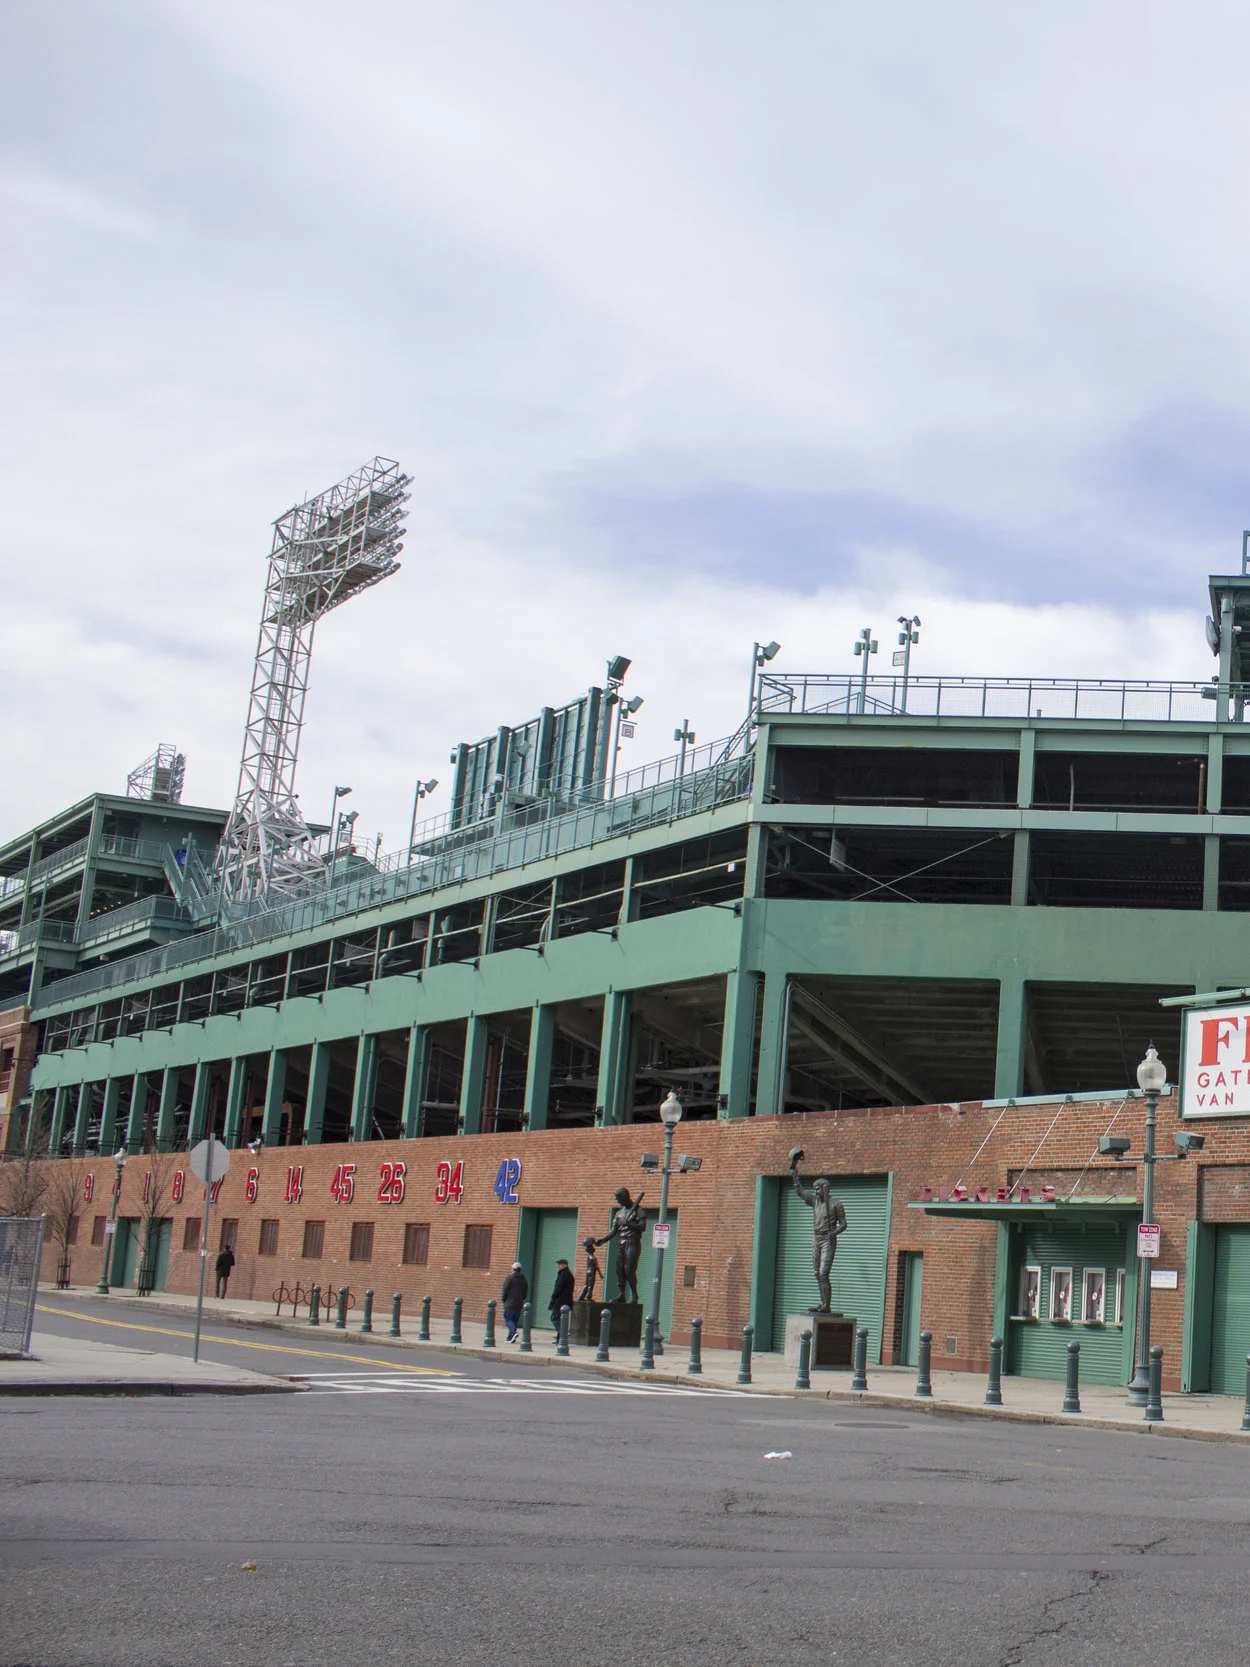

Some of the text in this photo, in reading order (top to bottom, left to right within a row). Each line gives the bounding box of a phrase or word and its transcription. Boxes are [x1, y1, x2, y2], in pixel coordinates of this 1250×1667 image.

[1196, 1093, 1234, 1107] VAN
[83, 1173, 94, 1203] 9
[171, 1170, 185, 1204] 8
[245, 1167, 259, 1203] 6
[284, 1165, 304, 1203] 14
[330, 1163, 357, 1204] 45
[377, 1162, 406, 1204] 26
[434, 1160, 464, 1204] 34
[493, 1158, 522, 1204] 42
[921, 1186, 1056, 1202] TICKETS
